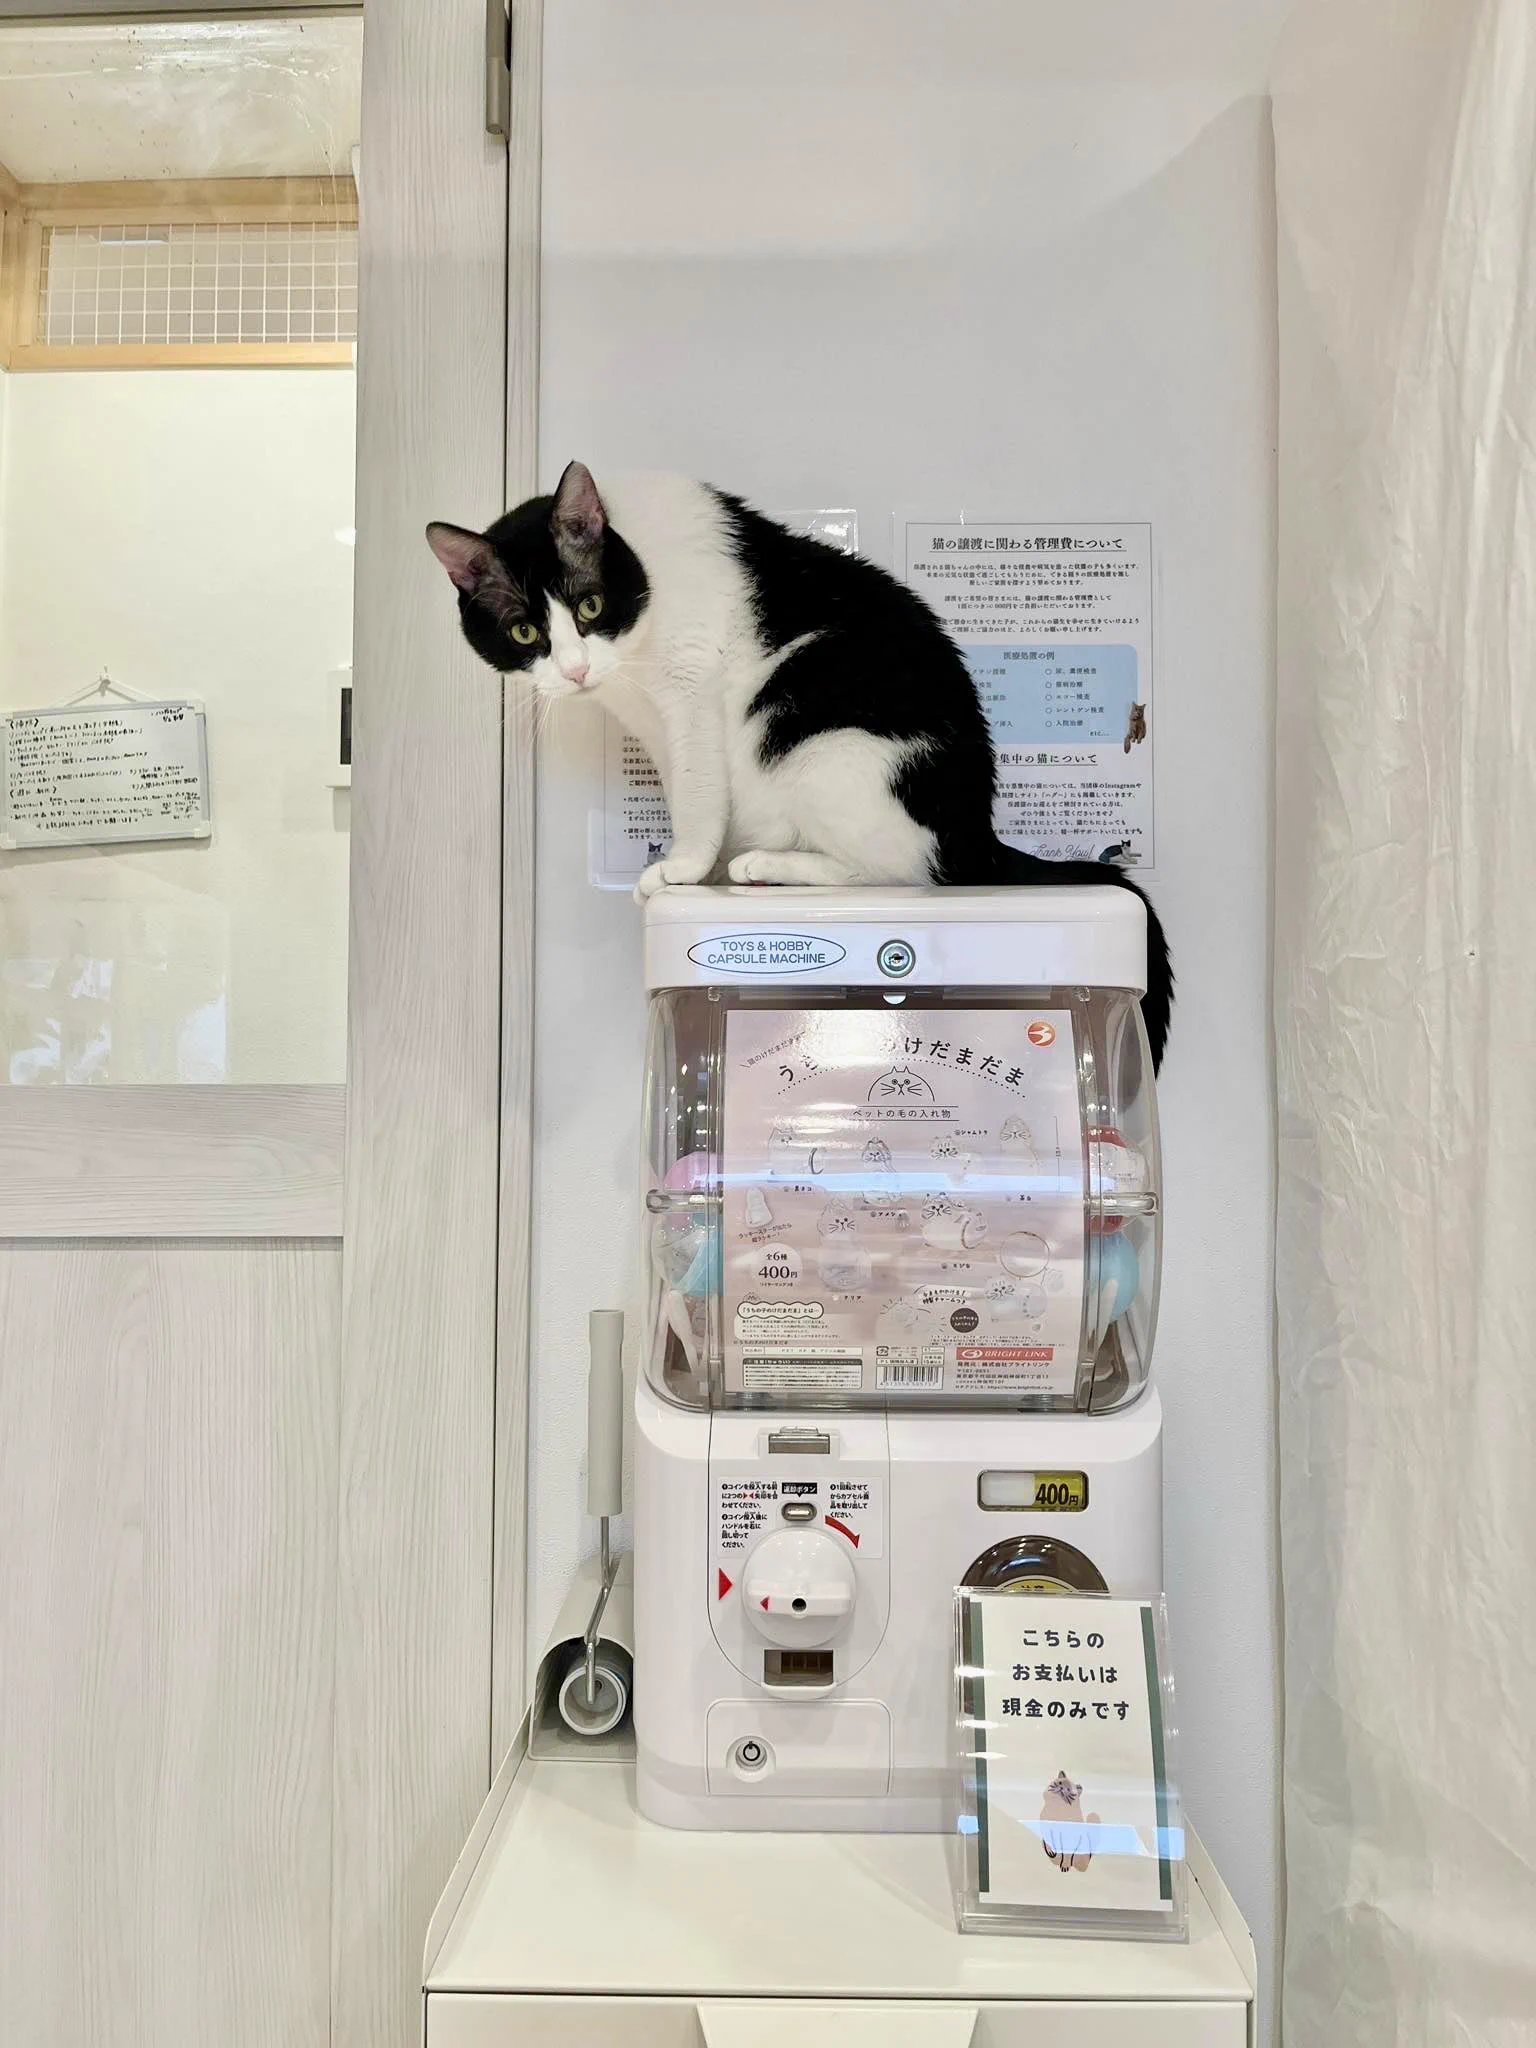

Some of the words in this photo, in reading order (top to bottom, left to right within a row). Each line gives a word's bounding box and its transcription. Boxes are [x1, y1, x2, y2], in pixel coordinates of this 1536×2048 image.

[932, 537, 1123, 550] 猫の譲渡に関わる管理費について
[1003, 651, 1055, 660] 医療処置の例
[1000, 753, 1097, 764] 集中の猫について
[721, 941, 754, 951] TOYS
[757, 941, 767, 951] &
[770, 941, 812, 951] HOBBY
[708, 953, 767, 963] CAPSULE
[770, 953, 825, 963] MACHINE
[853, 1107, 951, 1119] ペットの毛の入れ物
[766, 1251, 788, 1261] 全6種
[758, 1266, 798, 1279] 400円
[984, 1350, 1021, 1358] BRIGHT
[1024, 1350, 1048, 1358] LINK
[1035, 1483, 1079, 1505] 400円
[1023, 1629, 1105, 1649] こちらの
[1012, 1663, 1118, 1683] お支払いは
[1002, 1698, 1130, 1721] 現金のみです
